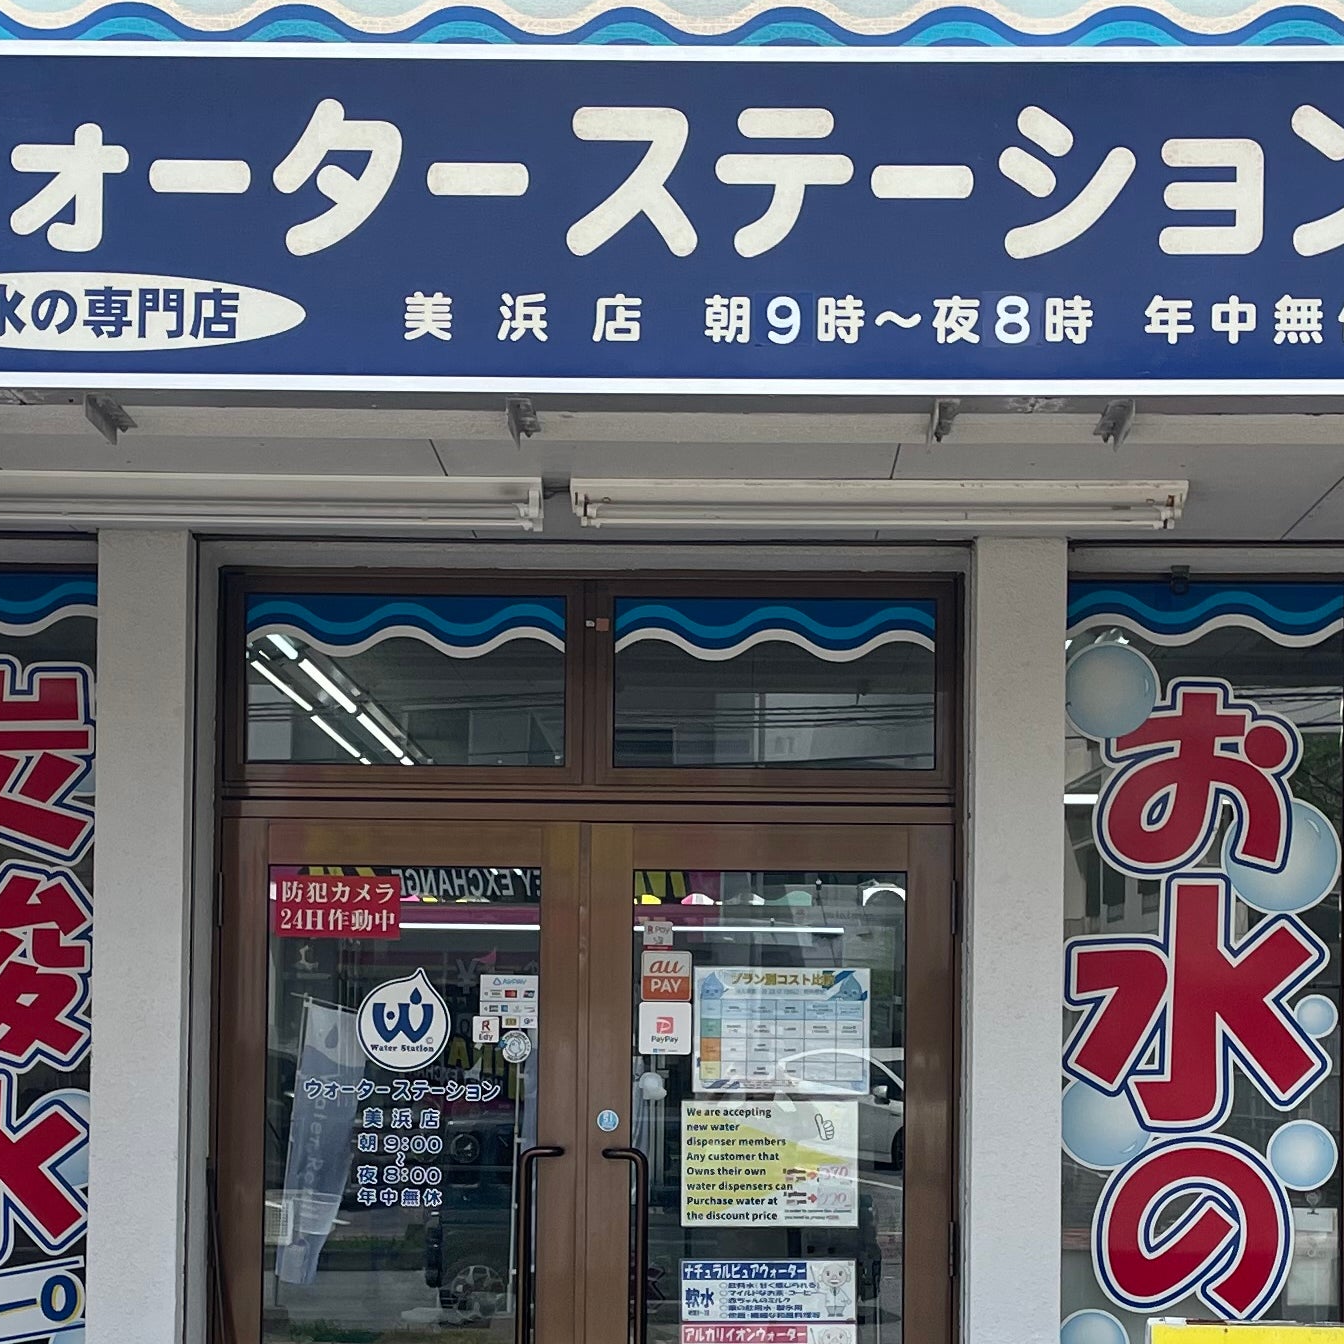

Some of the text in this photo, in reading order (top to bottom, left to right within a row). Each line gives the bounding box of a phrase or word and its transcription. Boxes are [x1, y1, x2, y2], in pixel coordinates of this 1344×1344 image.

[281, 881, 395, 903] 防犯カメラ
[280, 908, 396, 932] 24H作動中
[649, 960, 684, 974] au
[651, 979, 682, 993] PAY
[1066, 681, 1329, 1319] お水の
[651, 1036, 679, 1045] PayPay
[370, 1044, 434, 1052] Water Station
[304, 1079, 502, 1101] ウォーターステーション
[686, 1107, 772, 1119] We are accepting
[686, 1122, 740, 1131] new water
[686, 1136, 786, 1148] dispenser members
[686, 1151, 780, 1162] Any customer that
[686, 1167, 715, 1175] Owns
[717, 1166, 742, 1175] their
[686, 1181, 793, 1192] water dispensers can
[357, 1188, 443, 1206] 年中無休
[686, 1196, 737, 1205] Purchase
[740, 1197, 766, 1205] water
[768, 1197, 778, 1205] at
[686, 1211, 704, 1220] the
[706, 1211, 749, 1220] discount
[751, 1211, 778, 1221] price
[684, 1264, 806, 1280] ナチュラルピュアウォーター
[684, 1327, 806, 1343] アルカリイオンウォーター
